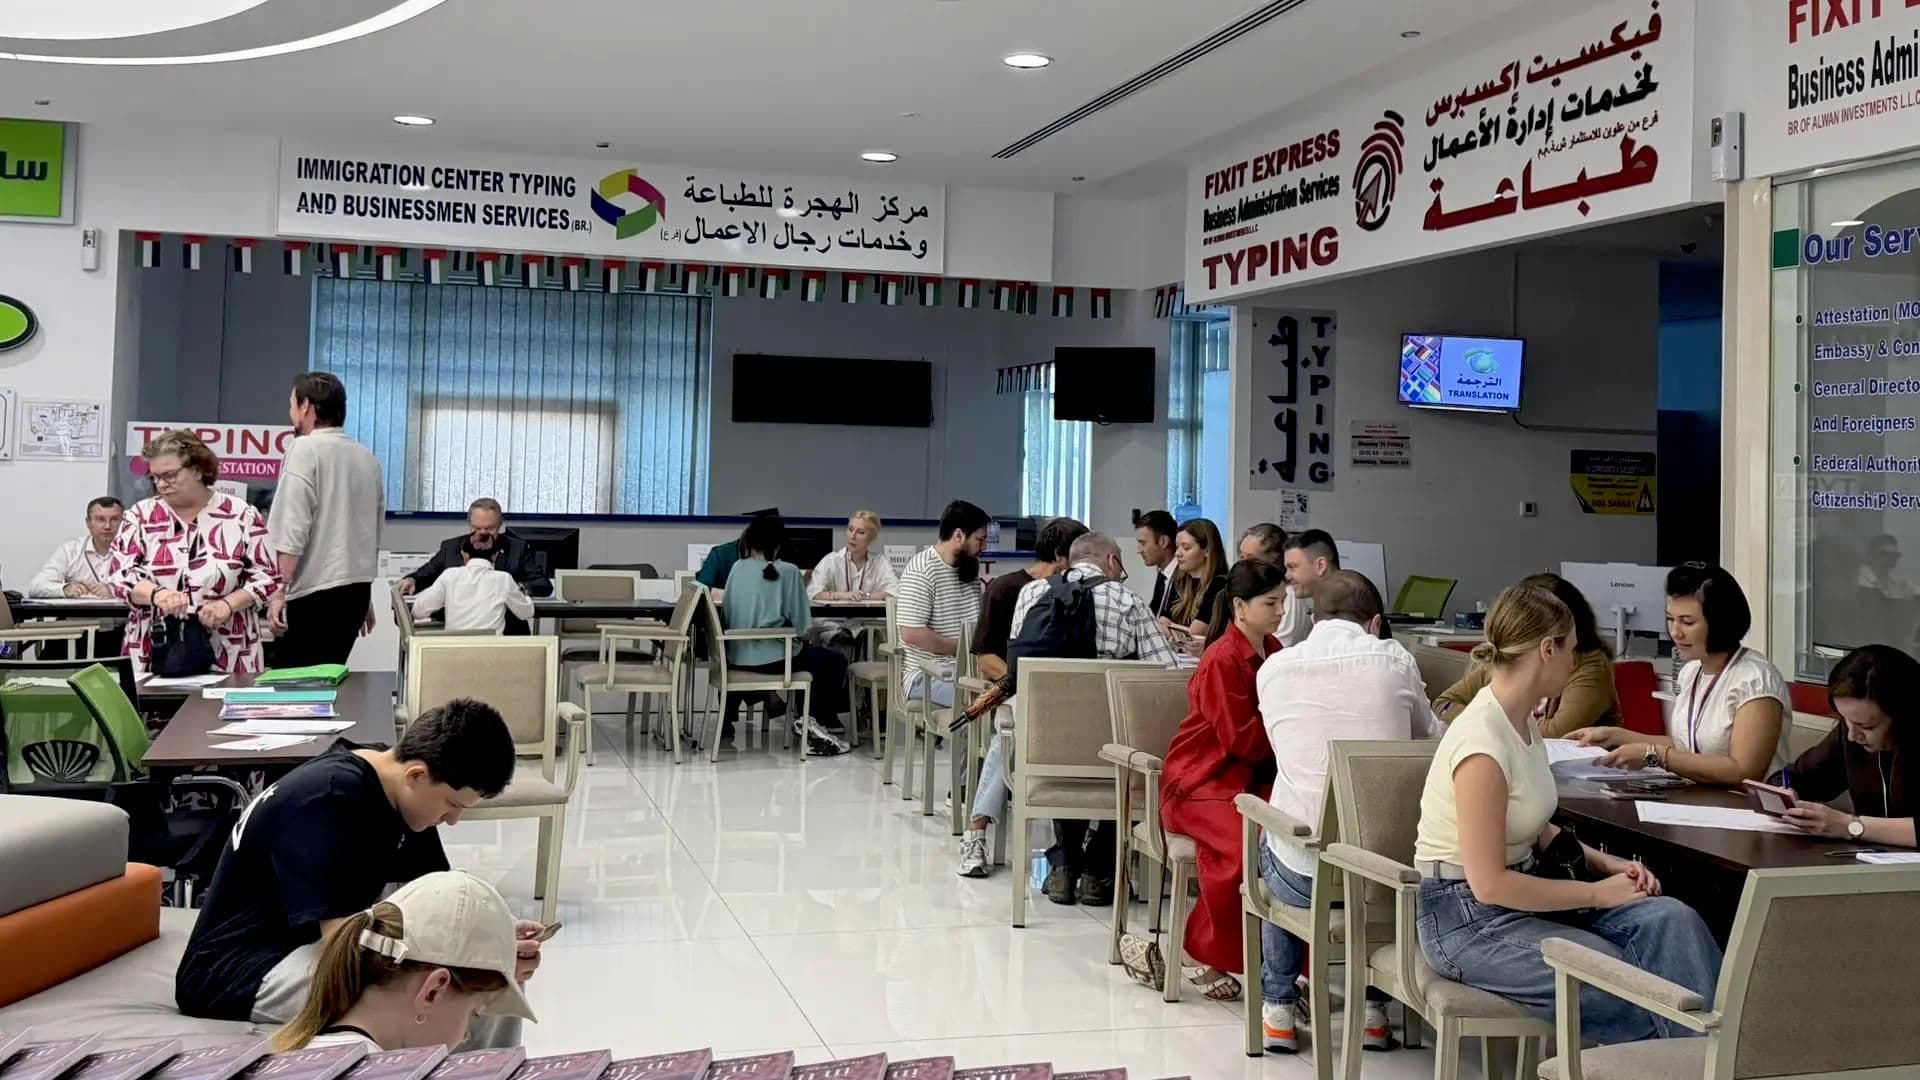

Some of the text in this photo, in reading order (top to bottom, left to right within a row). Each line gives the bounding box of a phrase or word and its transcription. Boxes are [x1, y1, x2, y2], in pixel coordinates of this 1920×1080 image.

[1425, 0, 1662, 127] فيكسيت إكسبرس
[1788, 56, 1866, 110] Business
[1423, 62, 1659, 172] لخدمات إدارة الأعمال
[1788, 120, 1799, 136] BR
[1800, 116, 1811, 132] OF
[1812, 110, 1840, 130] ALWAN
[1841, 95, 1899, 122] INVESTMENTS
[297, 157, 576, 198] IMMIGRATION CENTER TYPING
[1204, 129, 1340, 199] FIXIT EXPRESS
[1299, 172, 1340, 205] Services
[1423, 132, 1658, 232] طباعة
[296, 191, 593, 234] AND BUSINESSMEN SERVICES (BR.)
[684, 176, 928, 224] مركز الهجرة للطباعة
[684, 216, 766, 244] الاعمال
[773, 221, 831, 253] رجال
[1202, 226, 1339, 290] TYPING
[1804, 233, 1855, 265] Our
[1814, 306, 1889, 326] Attestation
[1814, 342, 1875, 362] Embassy
[1877, 340, 1888, 357] &
[1448, 389, 1510, 401] TRANSLATION
[1457, 373, 1502, 389] الترجمة
[1813, 379, 1866, 398] General
[1308, 316, 1332, 484] TYPING
[1812, 413, 1916, 435] And Foreigners
[1813, 454, 1863, 471] Federal
[1609, 581, 1635, 589] Lenovo
